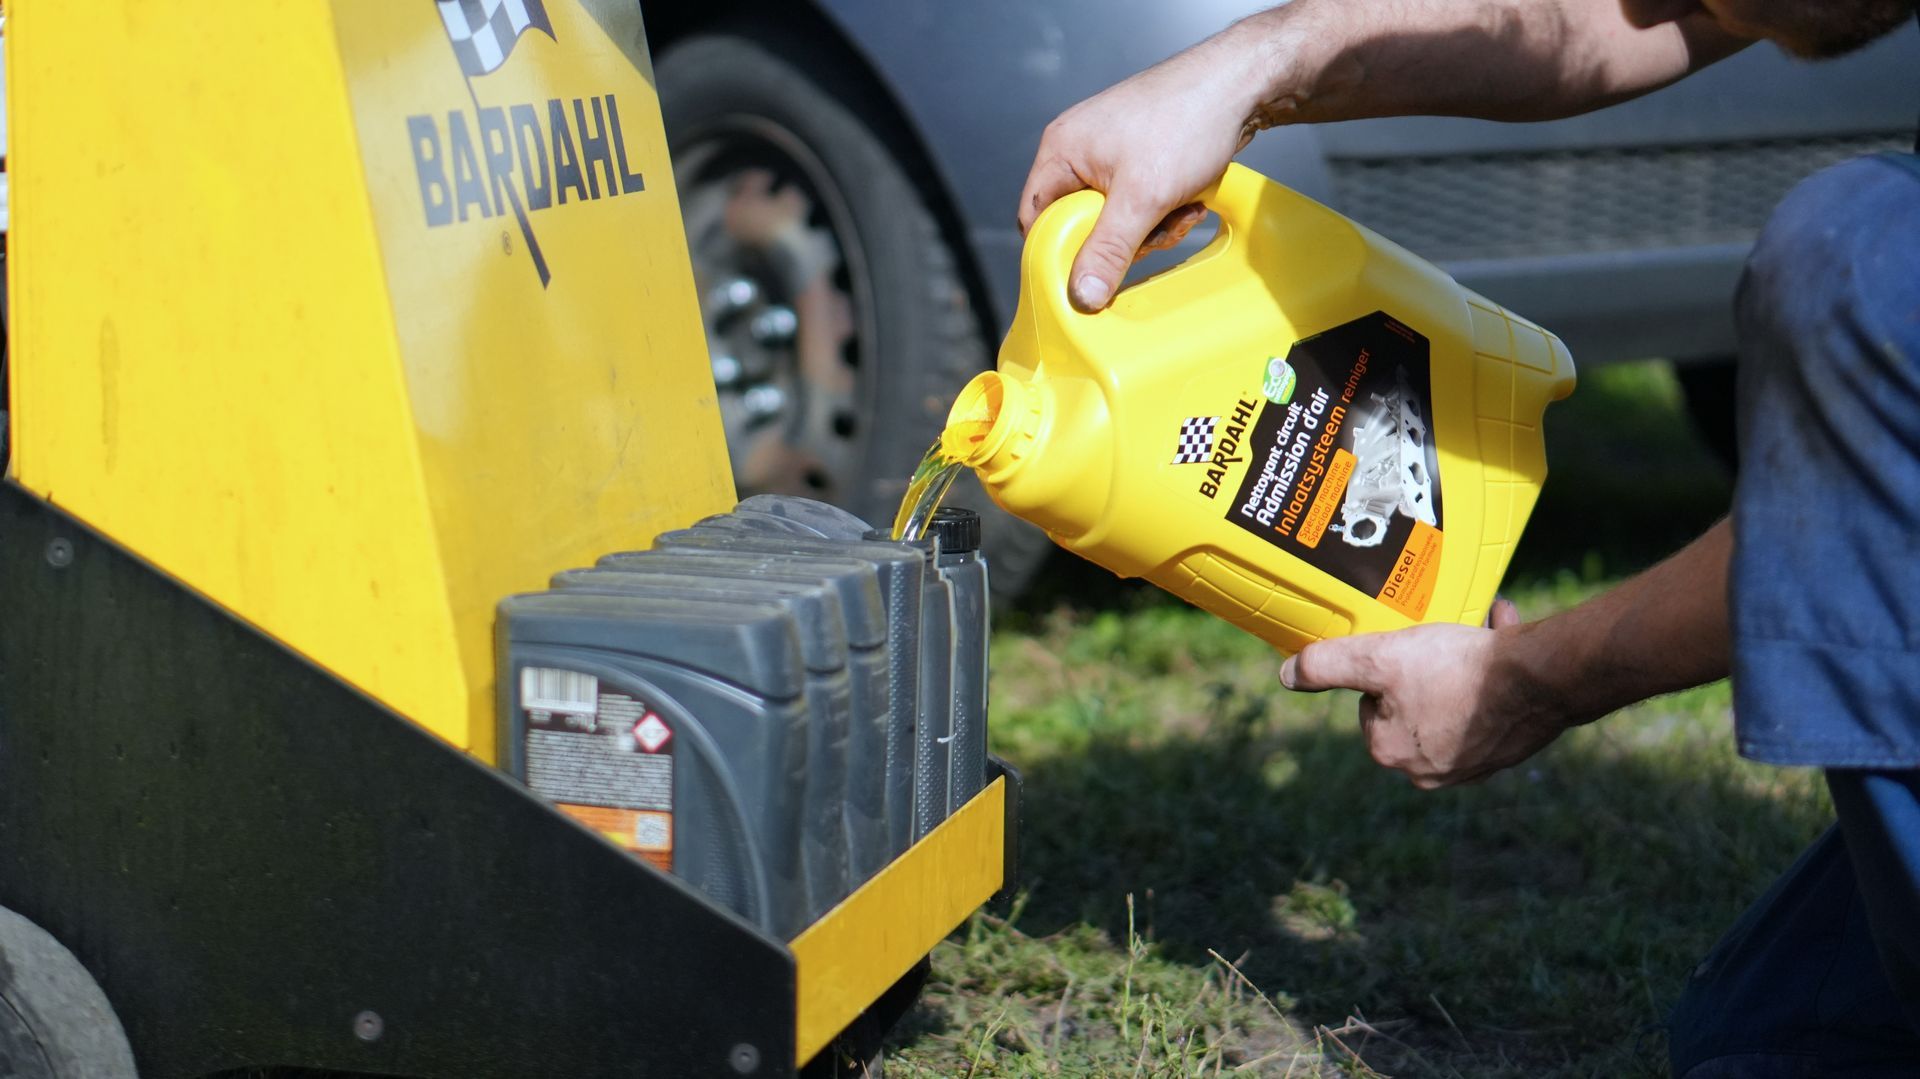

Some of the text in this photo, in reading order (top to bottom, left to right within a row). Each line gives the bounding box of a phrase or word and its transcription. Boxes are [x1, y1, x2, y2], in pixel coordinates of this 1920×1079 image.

[406, 94, 645, 290] BARDAHL
[1199, 399, 1258, 499] BARDAHL
[1256, 432, 1311, 526] Admission
[1302, 387, 1330, 430] d'air
[1275, 405, 1346, 536] Inlaatsysteem
[1341, 348, 1370, 403] reiniger
[1277, 402, 1303, 446] circuit
[1308, 461, 1352, 542] Speciaal machine
[1319, 462, 1341, 503] machine
[1383, 549, 1416, 598] Diesel
